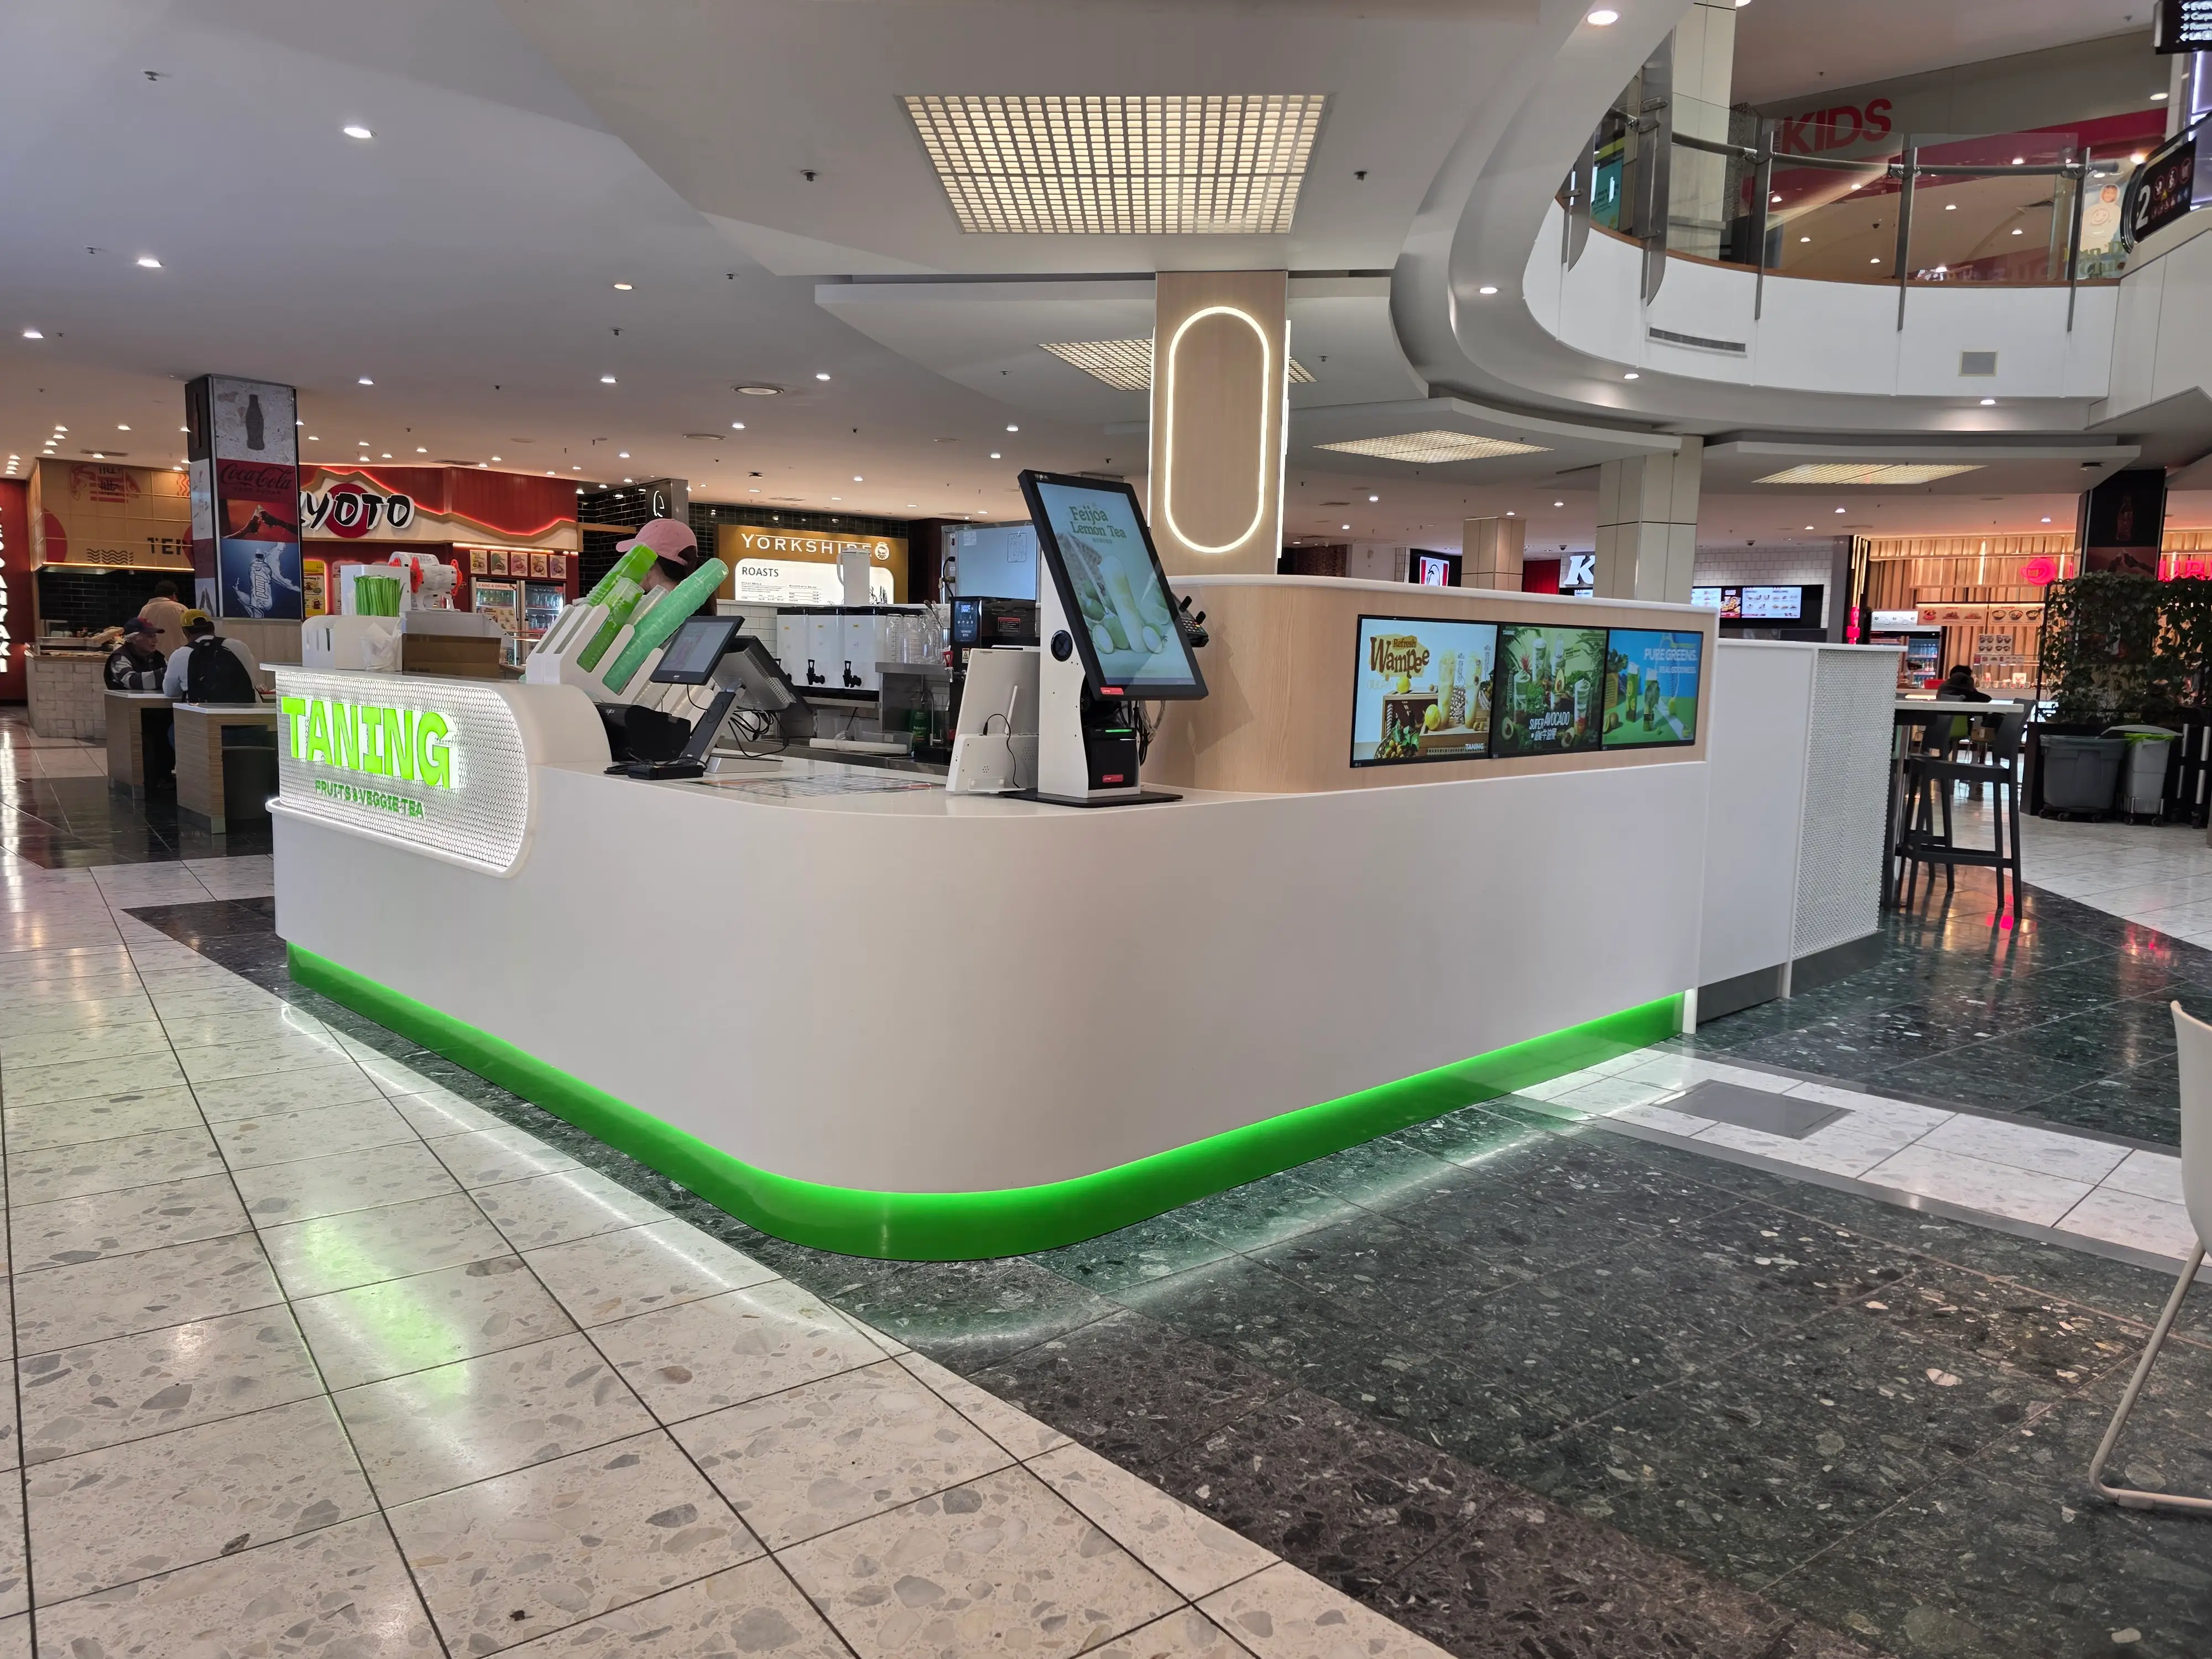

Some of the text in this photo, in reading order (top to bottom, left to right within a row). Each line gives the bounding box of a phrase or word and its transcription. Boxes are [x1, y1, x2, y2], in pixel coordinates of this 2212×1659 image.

[1781, 98, 1892, 155] KIDS
[2136, 184, 2151, 230] 2
[221, 463, 295, 490] Coca-Cola
[300, 490, 415, 530] YOTO
[1068, 505, 1109, 525] Feijoa
[1070, 521, 1127, 539] Lemon Tea
[741, 533, 872, 556] YORKSHI
[742, 566, 779, 577] ROASTS
[1563, 555, 1596, 586] K
[254, 574, 269, 599] pump
[1393, 638, 1416, 649] Refresh
[1644, 648, 1665, 661] PURE
[1370, 636, 1430, 679] Wampee
[1529, 711, 1570, 730] SUPER AVOCADO
[280, 696, 460, 790] TANING
[315, 779, 425, 819] FRUITS & VEGGIE TEA
